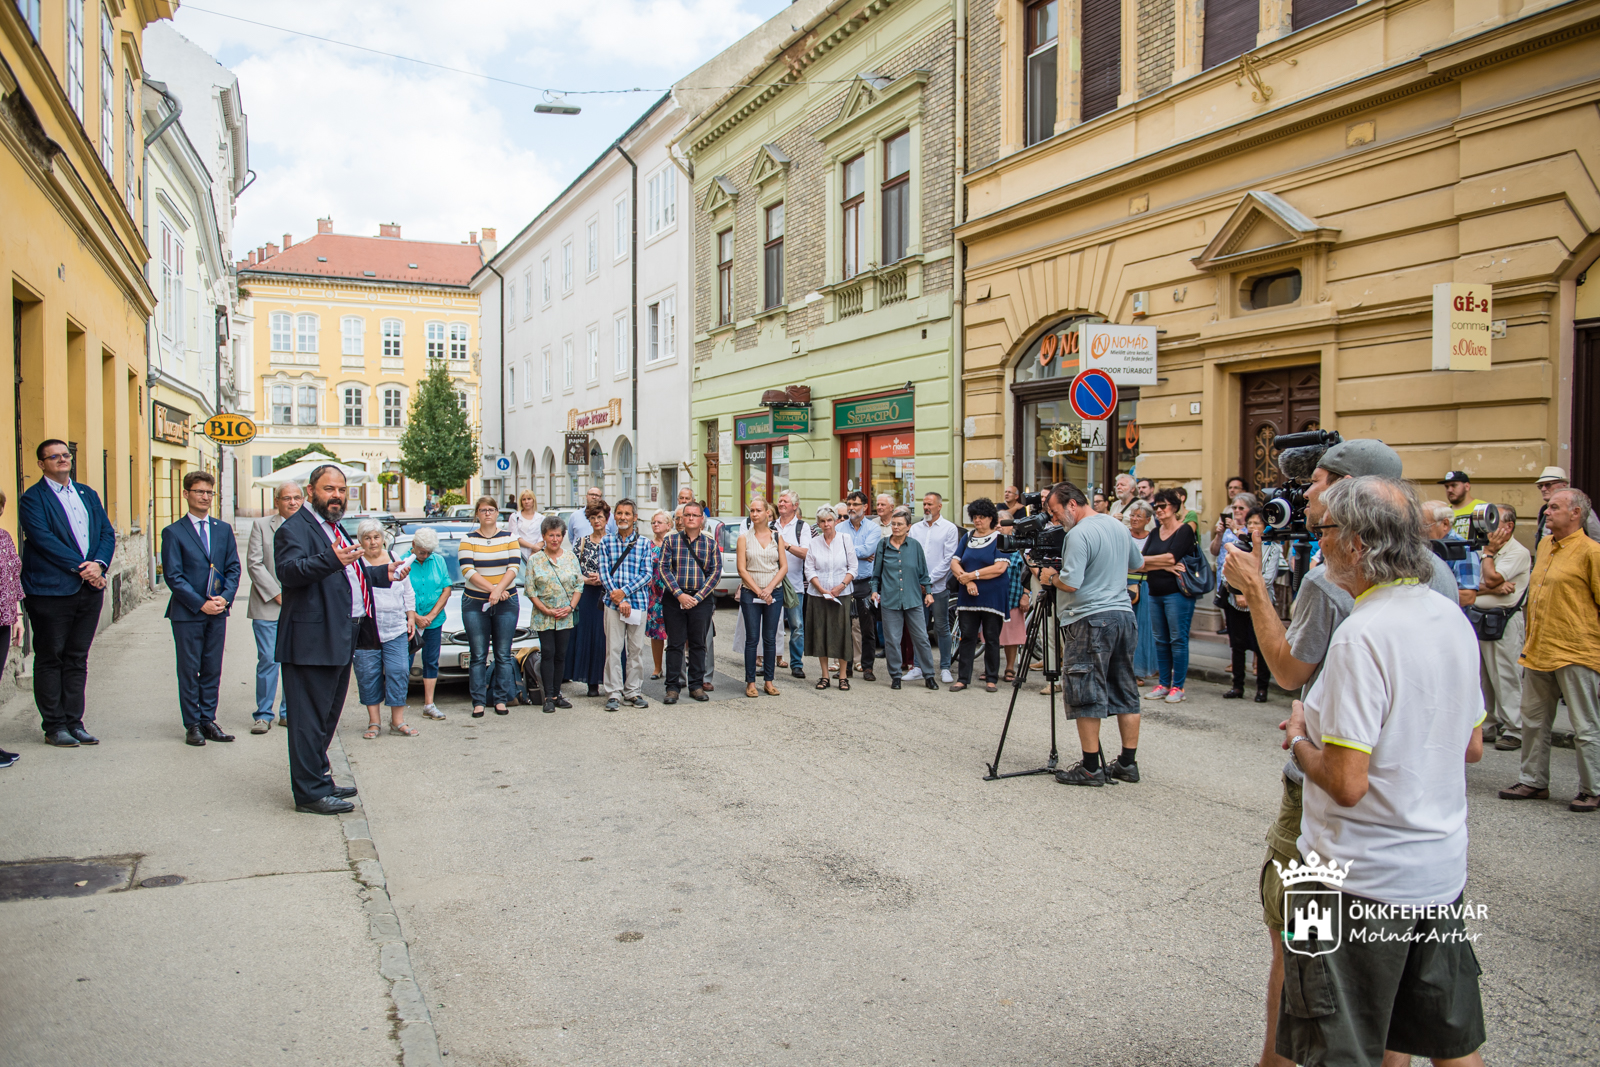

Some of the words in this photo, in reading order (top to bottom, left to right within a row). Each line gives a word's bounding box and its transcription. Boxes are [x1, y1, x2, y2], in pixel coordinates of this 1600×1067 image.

[1453, 291, 1489, 313] GÉ-2
[1111, 334, 1149, 350] NOMÁD
[1452, 338, 1488, 357] s.Oliver
[1122, 366, 1153, 374] TÚRABOLT
[210, 421, 253, 437] BIC
